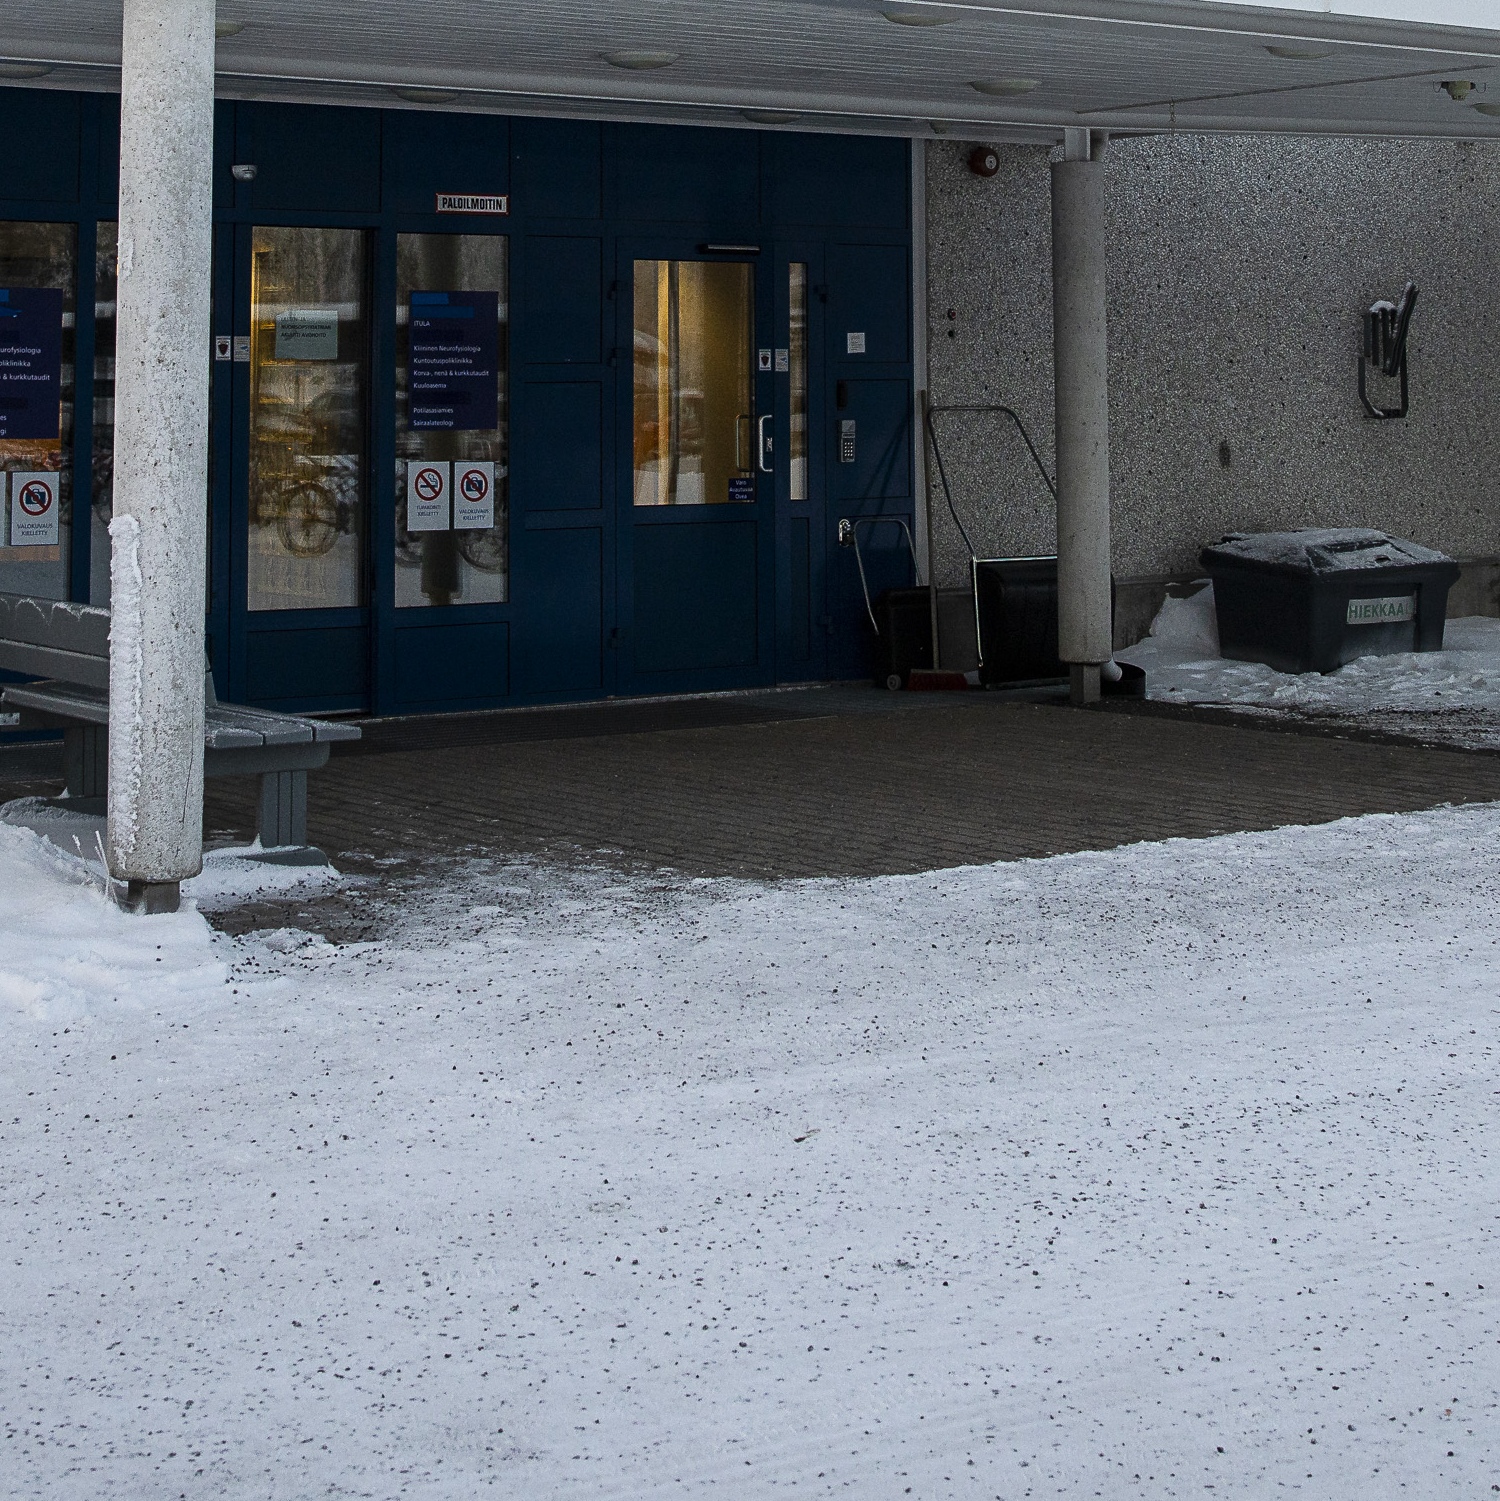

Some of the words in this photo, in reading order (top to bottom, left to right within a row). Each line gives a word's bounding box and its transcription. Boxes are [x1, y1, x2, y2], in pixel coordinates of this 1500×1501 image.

[442, 197, 503, 210] PALOILMOITIN
[439, 345, 481, 353] Neurofysiologia
[413, 357, 473, 365] Kuntoutuspoliklinikka
[9, 373, 50, 381] kurkkutaudit
[413, 419, 454, 427] Sairaalateologi
[16, 522, 53, 530] VALOKUVAUS
